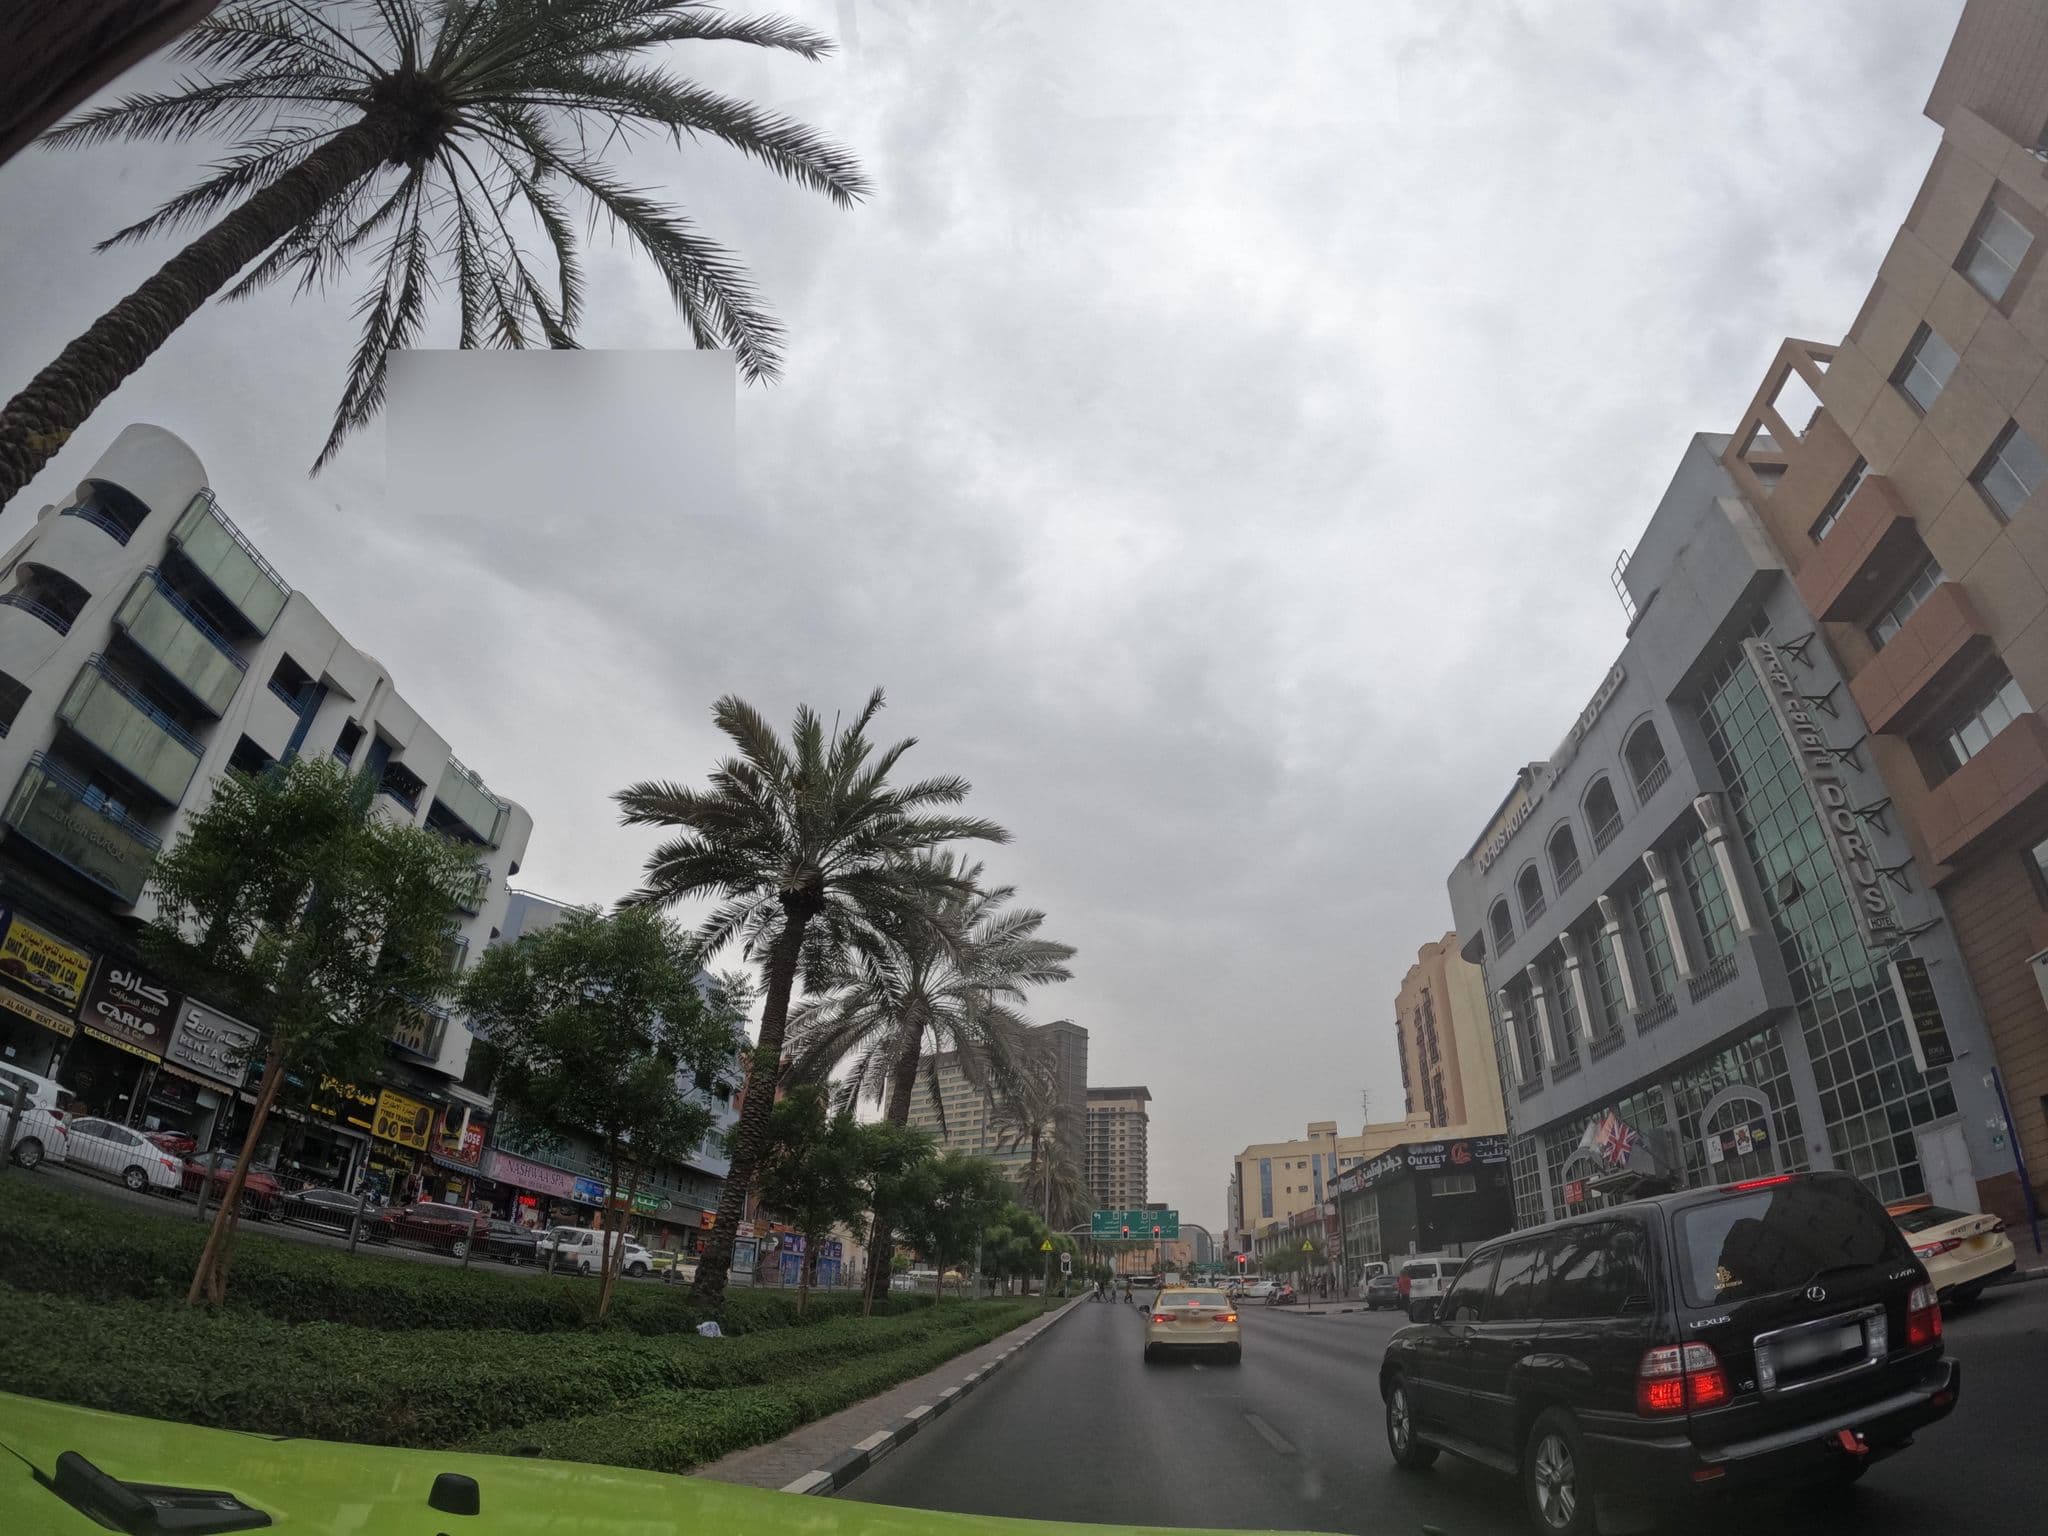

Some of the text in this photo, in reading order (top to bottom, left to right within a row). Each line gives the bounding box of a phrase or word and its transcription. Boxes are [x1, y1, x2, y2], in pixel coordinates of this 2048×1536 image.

[1819, 783, 1887, 912] DORUS
[1871, 917, 1895, 929] HOTEL
[109, 970, 169, 1007] كارلو
[15, 1002, 33, 1017] ARAB
[35, 1011, 52, 1026] RENT
[58, 1022, 71, 1034] CAR
[97, 1001, 156, 1035] CARLO
[184, 1009, 217, 1039] Sam
[178, 1033, 210, 1054] RENT
[210, 1048, 218, 1058] A
[463, 1131, 481, 1145] ROSE
[1407, 1154, 1446, 1166] OUTLET
[549, 1171, 565, 1186] SPA
[1689, 1315, 1732, 1330] LEXUS
